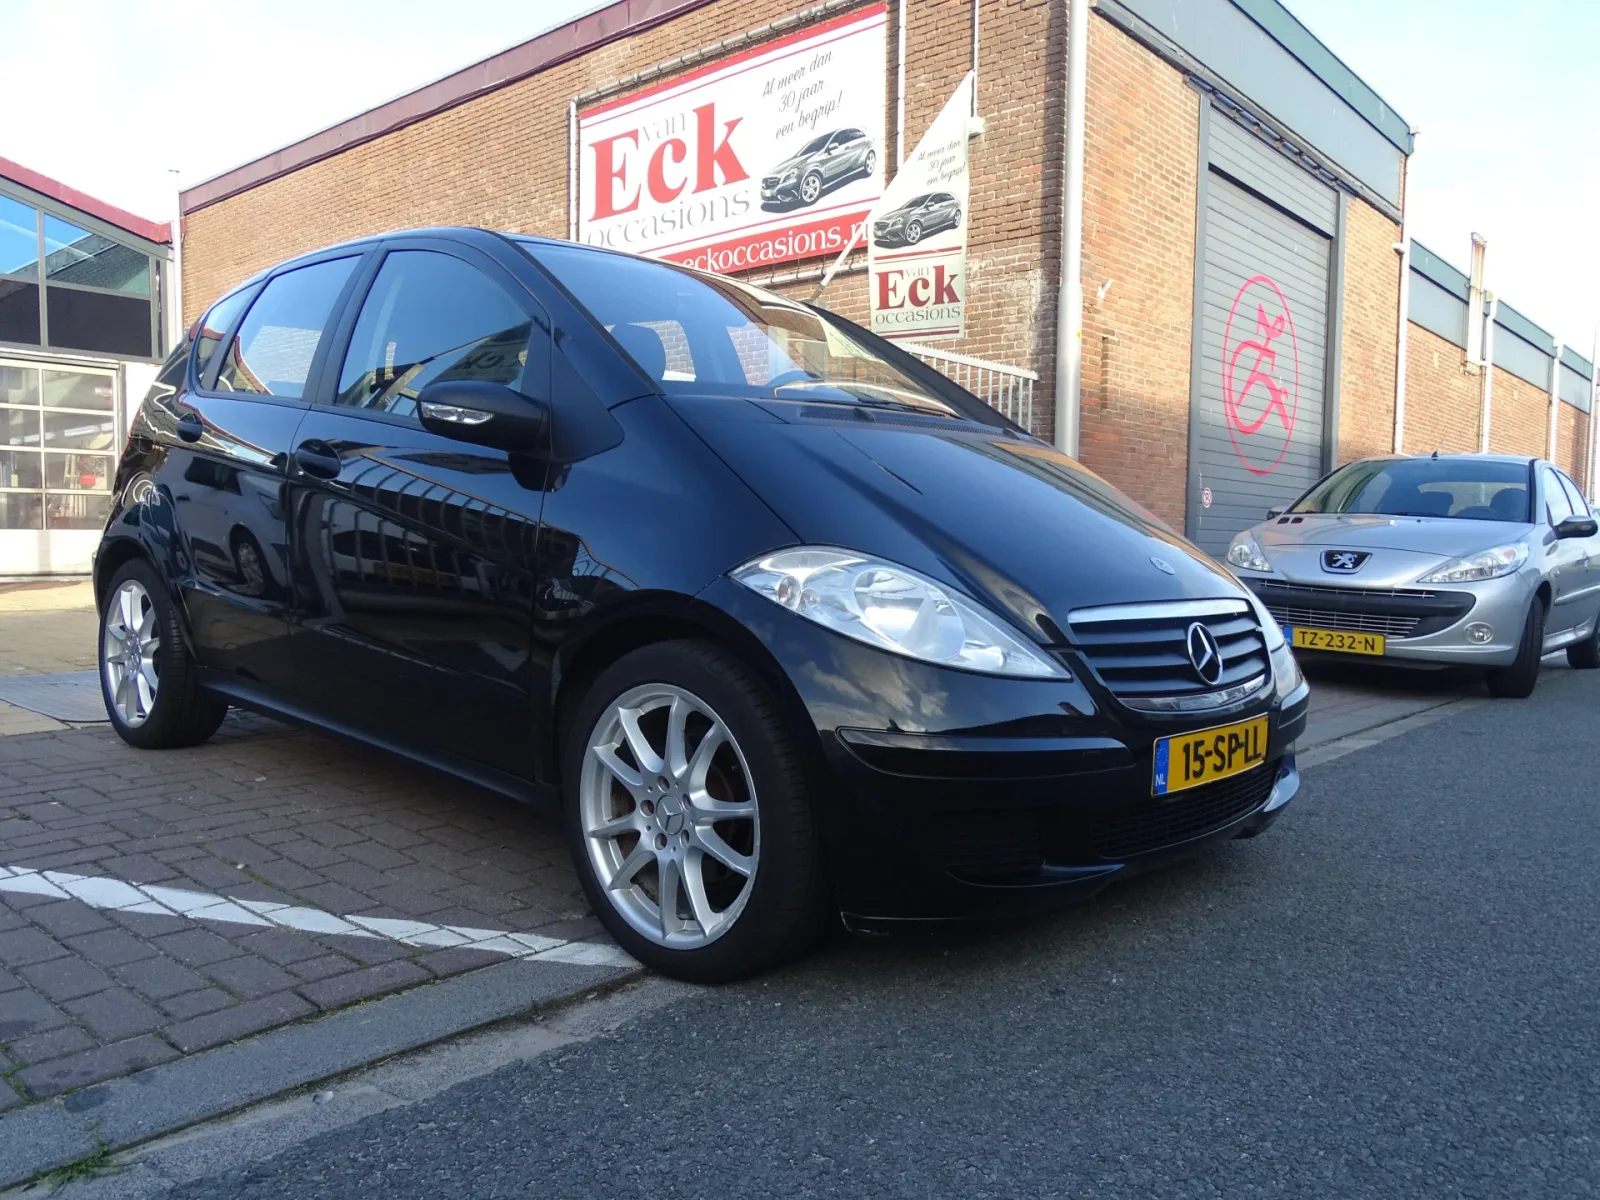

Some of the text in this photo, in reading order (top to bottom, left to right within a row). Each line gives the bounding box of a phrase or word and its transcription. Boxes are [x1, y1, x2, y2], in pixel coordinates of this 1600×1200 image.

[762, 51, 832, 98] Al meer dan
[778, 79, 824, 114] 30 jaar
[643, 112, 686, 141] van
[776, 89, 843, 140] een begrip!
[587, 102, 750, 222] Eck
[928, 155, 956, 173] 30 jaar
[926, 176, 939, 187] een
[587, 189, 750, 248] occasions
[676, 219, 868, 273] eckoccasions.n
[875, 264, 961, 311] Eck
[905, 266, 929, 278] van
[875, 305, 961, 325] occasions
[1299, 631, 1375, 652] TZ-232-N
[1182, 725, 1262, 781] 15-SP-LL
[1155, 773, 1166, 787] NL
